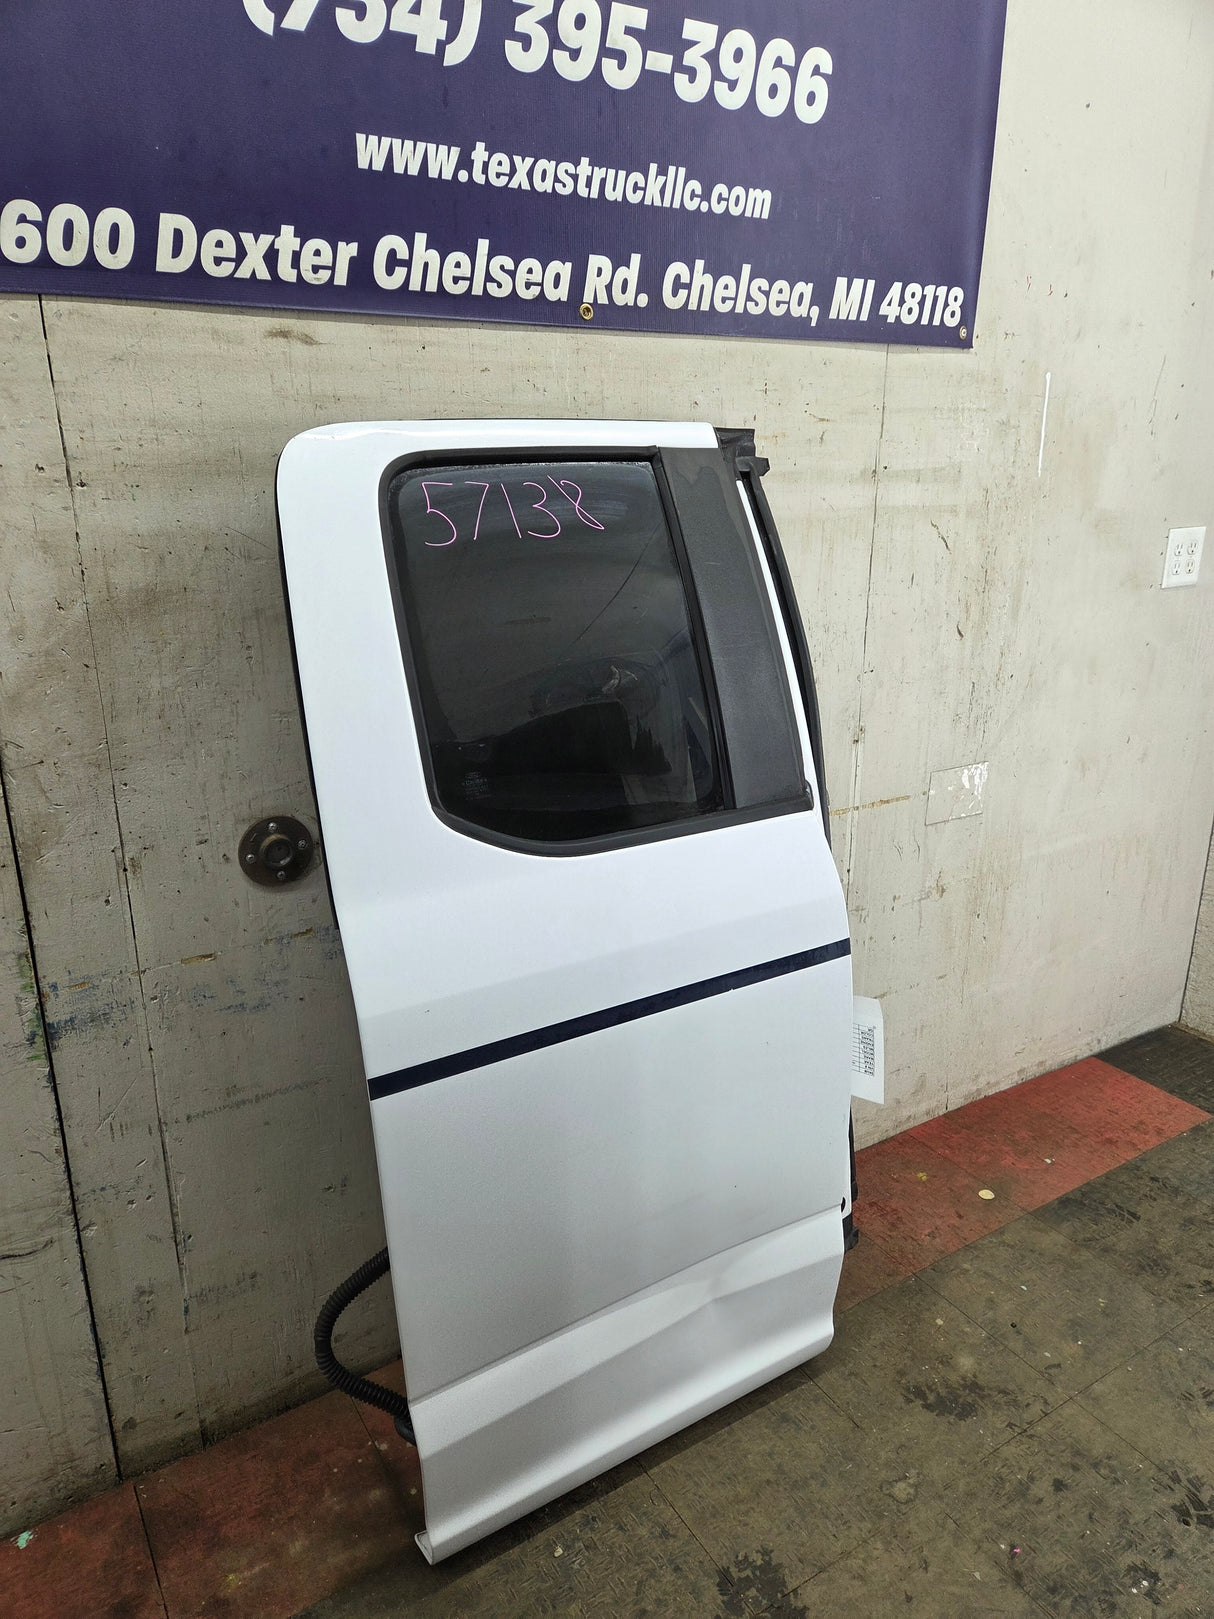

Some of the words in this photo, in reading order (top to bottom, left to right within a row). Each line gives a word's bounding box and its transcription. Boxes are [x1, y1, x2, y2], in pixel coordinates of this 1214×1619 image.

[505, 0, 833, 124] 395-3966
[356, 133, 771, 219] www.texastruckllc.com
[0, 199, 135, 269] 600
[156, 213, 358, 286] Dexter
[374, 232, 572, 301] Chelsea
[583, 253, 648, 307] Rd.
[663, 259, 819, 326] Chelsea,
[829, 277, 875, 321] MI
[879, 282, 964, 327] 48118
[421, 475, 605, 547] 57138
